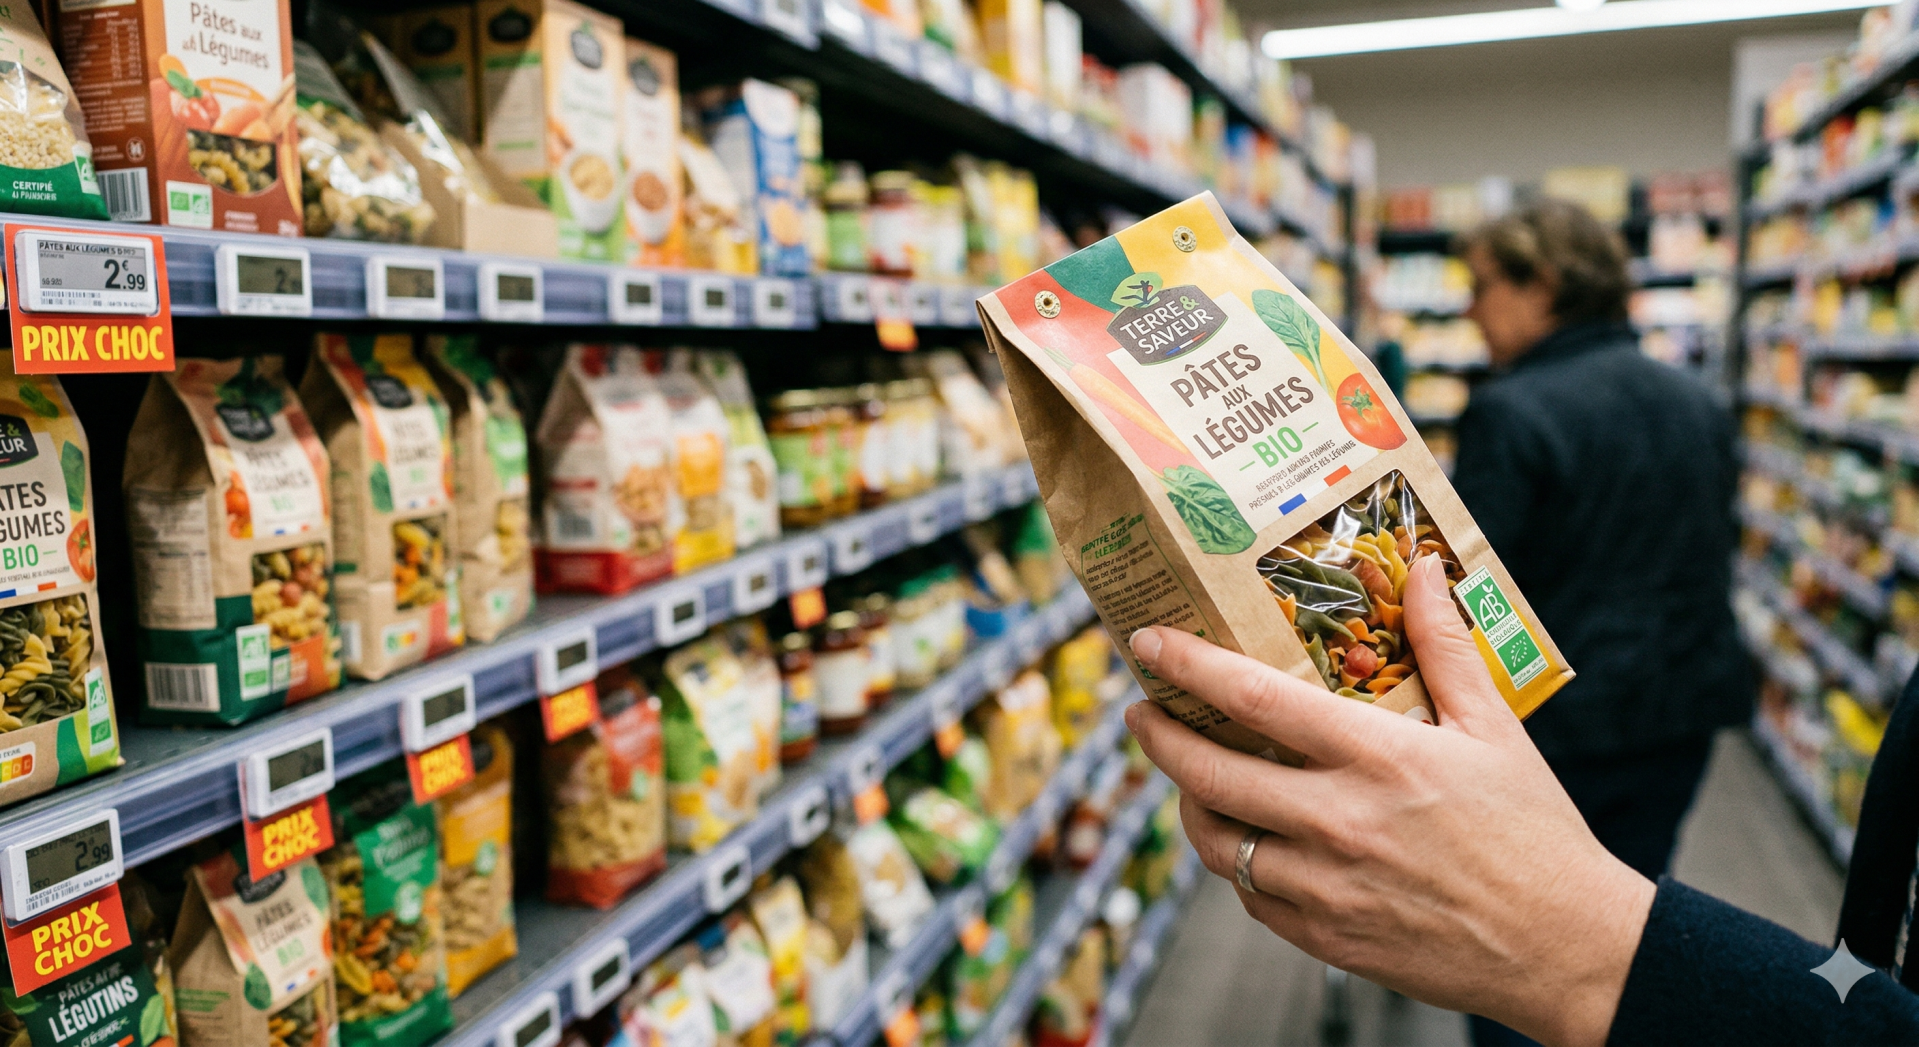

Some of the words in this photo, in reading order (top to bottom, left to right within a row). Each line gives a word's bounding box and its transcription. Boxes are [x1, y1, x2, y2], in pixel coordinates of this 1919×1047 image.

[190, 2, 237, 35] Pâtes
[199, 31, 270, 69] Légumes
[21, 325, 90, 362] PRIX
[95, 325, 165, 361] CHOC
[1137, 308, 1214, 355] SAVEUR
[1170, 343, 1262, 408] PÂTES
[1221, 384, 1253, 410] AUX
[1193, 376, 1315, 461] LÉGUMES
[1252, 425, 1303, 469] BIO
[2, 543, 39, 571] BIO
[1479, 592, 1506, 630] AB
[262, 805, 320, 847] PRIX
[262, 832, 321, 869] CHOC
[31, 901, 104, 953] PRIX
[34, 923, 113, 976] CHOC
[48, 975, 139, 1043] LÉGUTINS
[58, 976, 95, 1003] PÂTES
